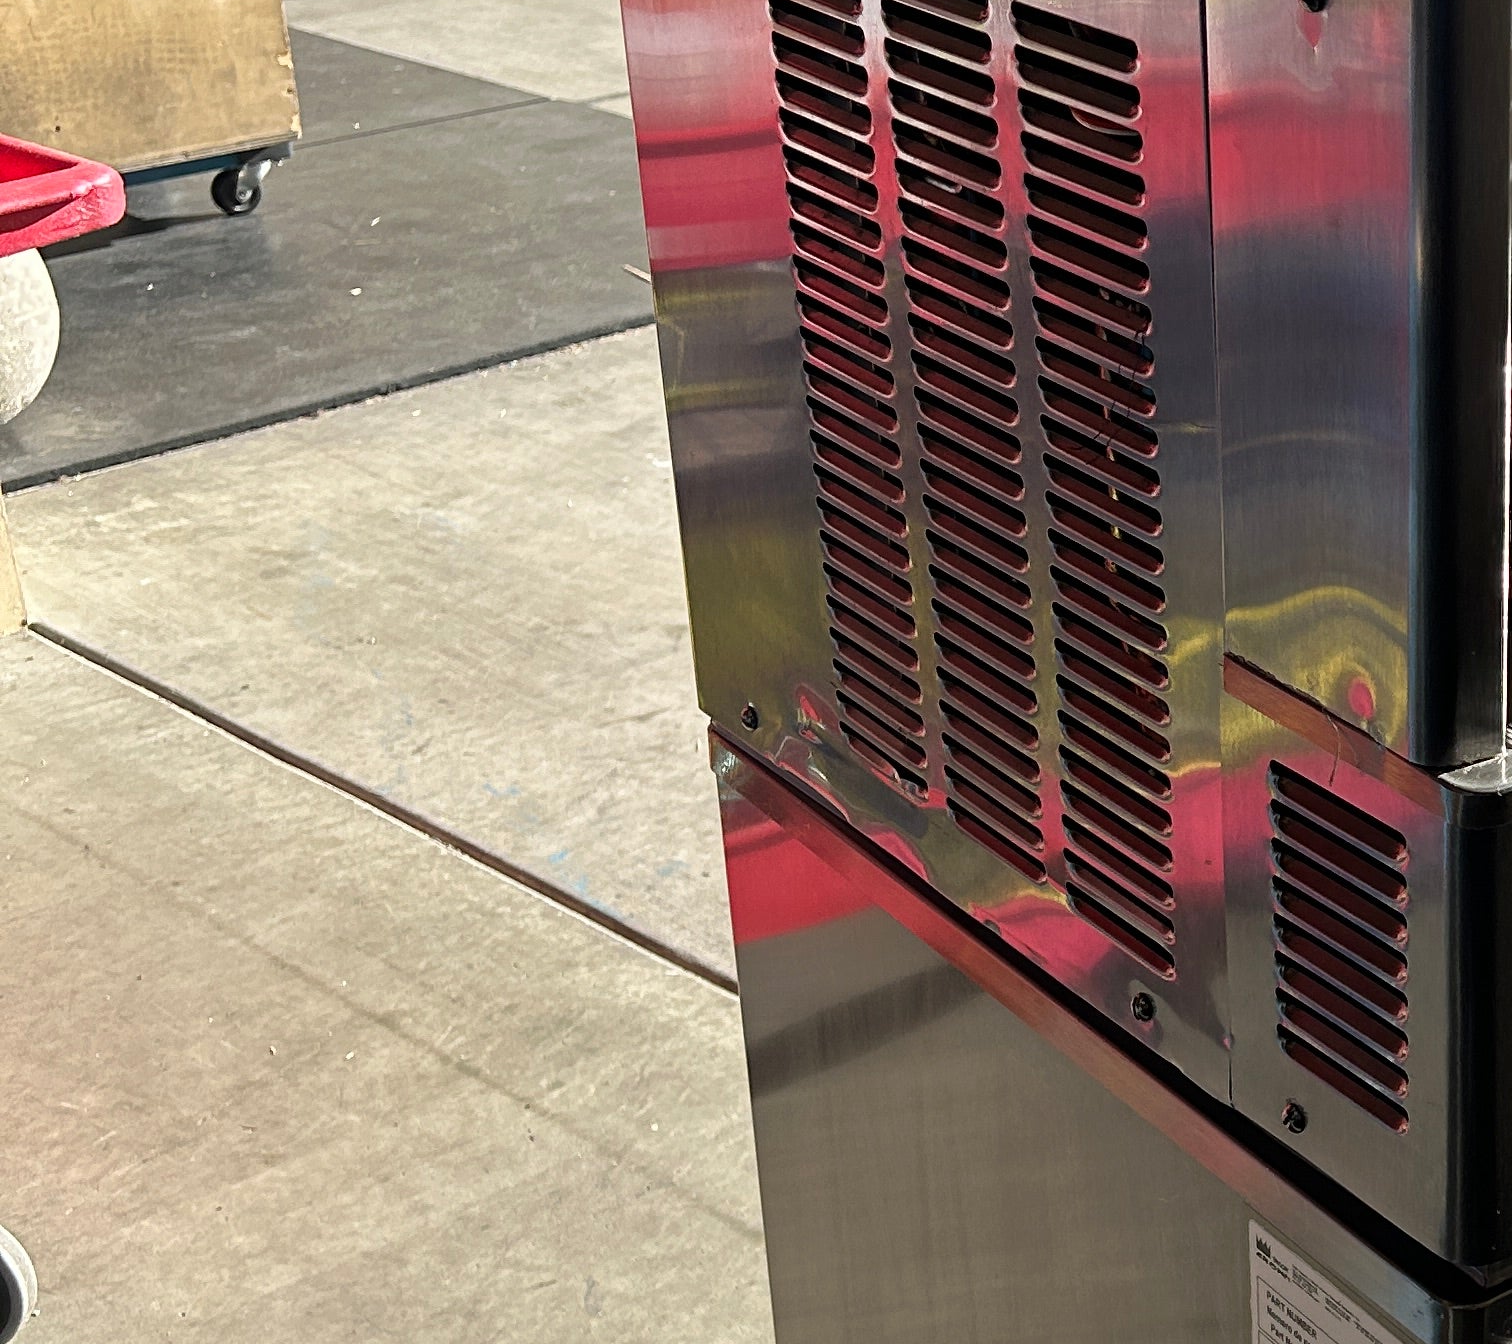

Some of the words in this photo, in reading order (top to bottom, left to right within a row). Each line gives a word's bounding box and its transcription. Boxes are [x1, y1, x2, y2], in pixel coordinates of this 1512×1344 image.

[1267, 1290, 1285, 1312] PART
[1287, 1306, 1317, 1340] NUMBER
[1270, 1323, 1284, 1342] Part
